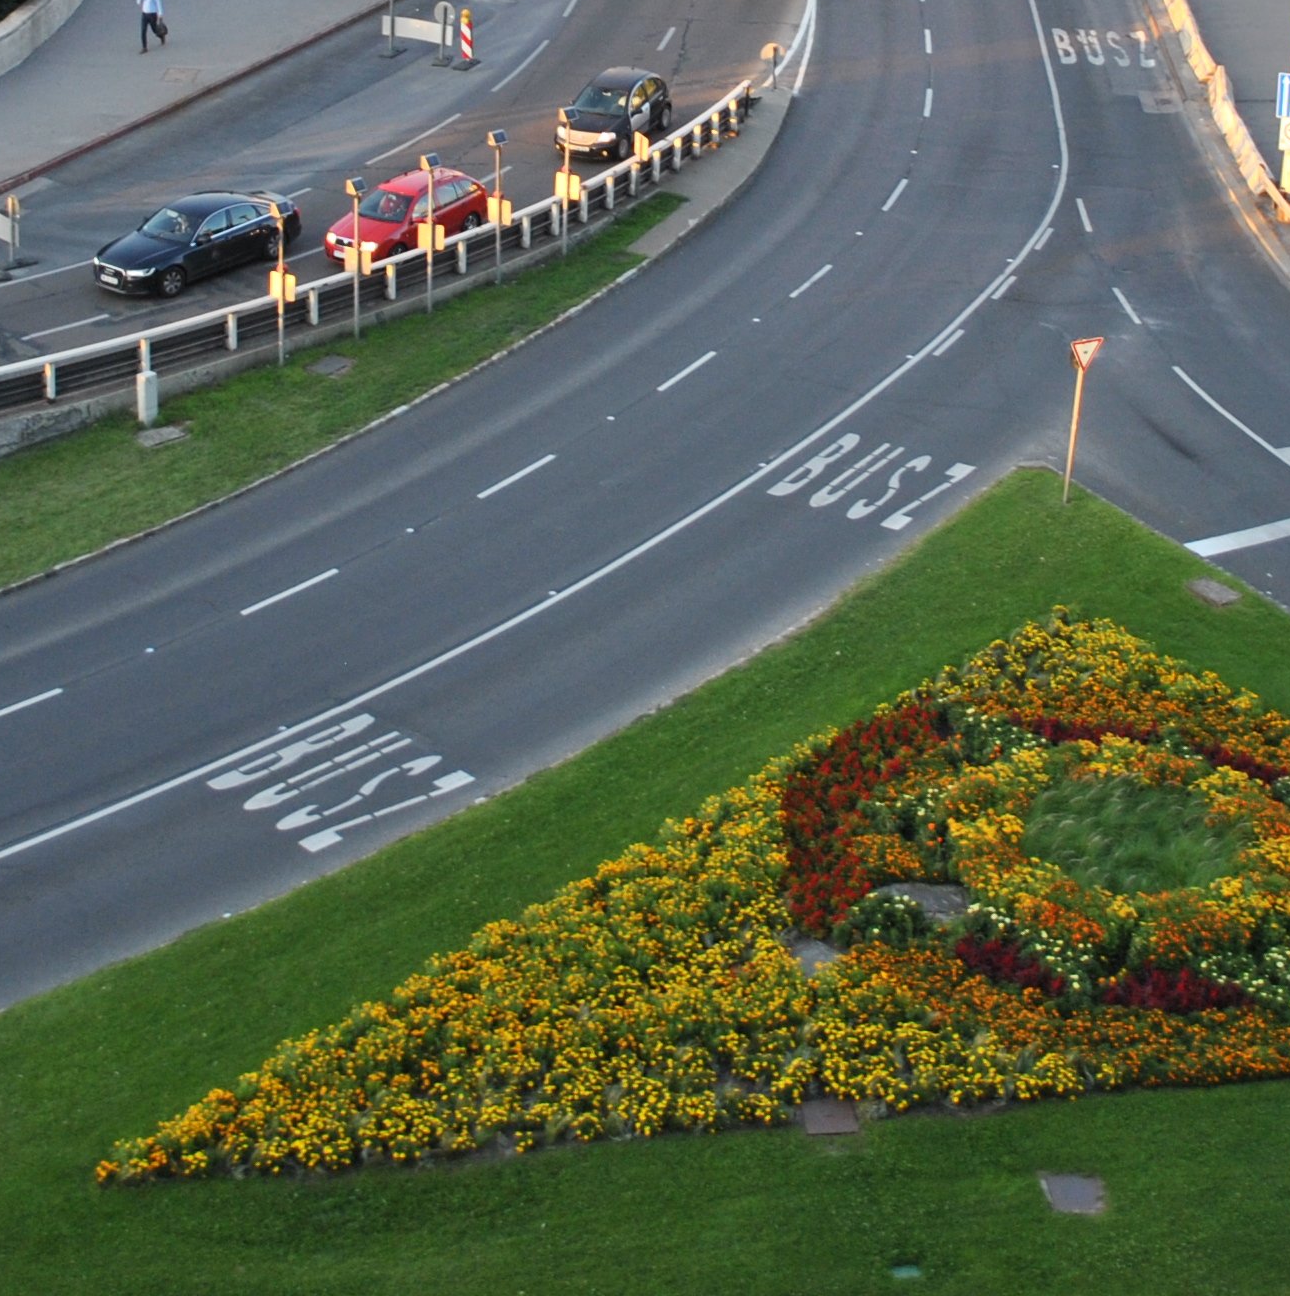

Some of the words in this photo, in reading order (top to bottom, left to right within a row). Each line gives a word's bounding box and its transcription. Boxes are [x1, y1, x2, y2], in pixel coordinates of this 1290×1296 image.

[1051, 27, 1156, 69] BUSZ
[766, 433, 977, 531] BUSZ
[206, 713, 476, 853] BUSZ
